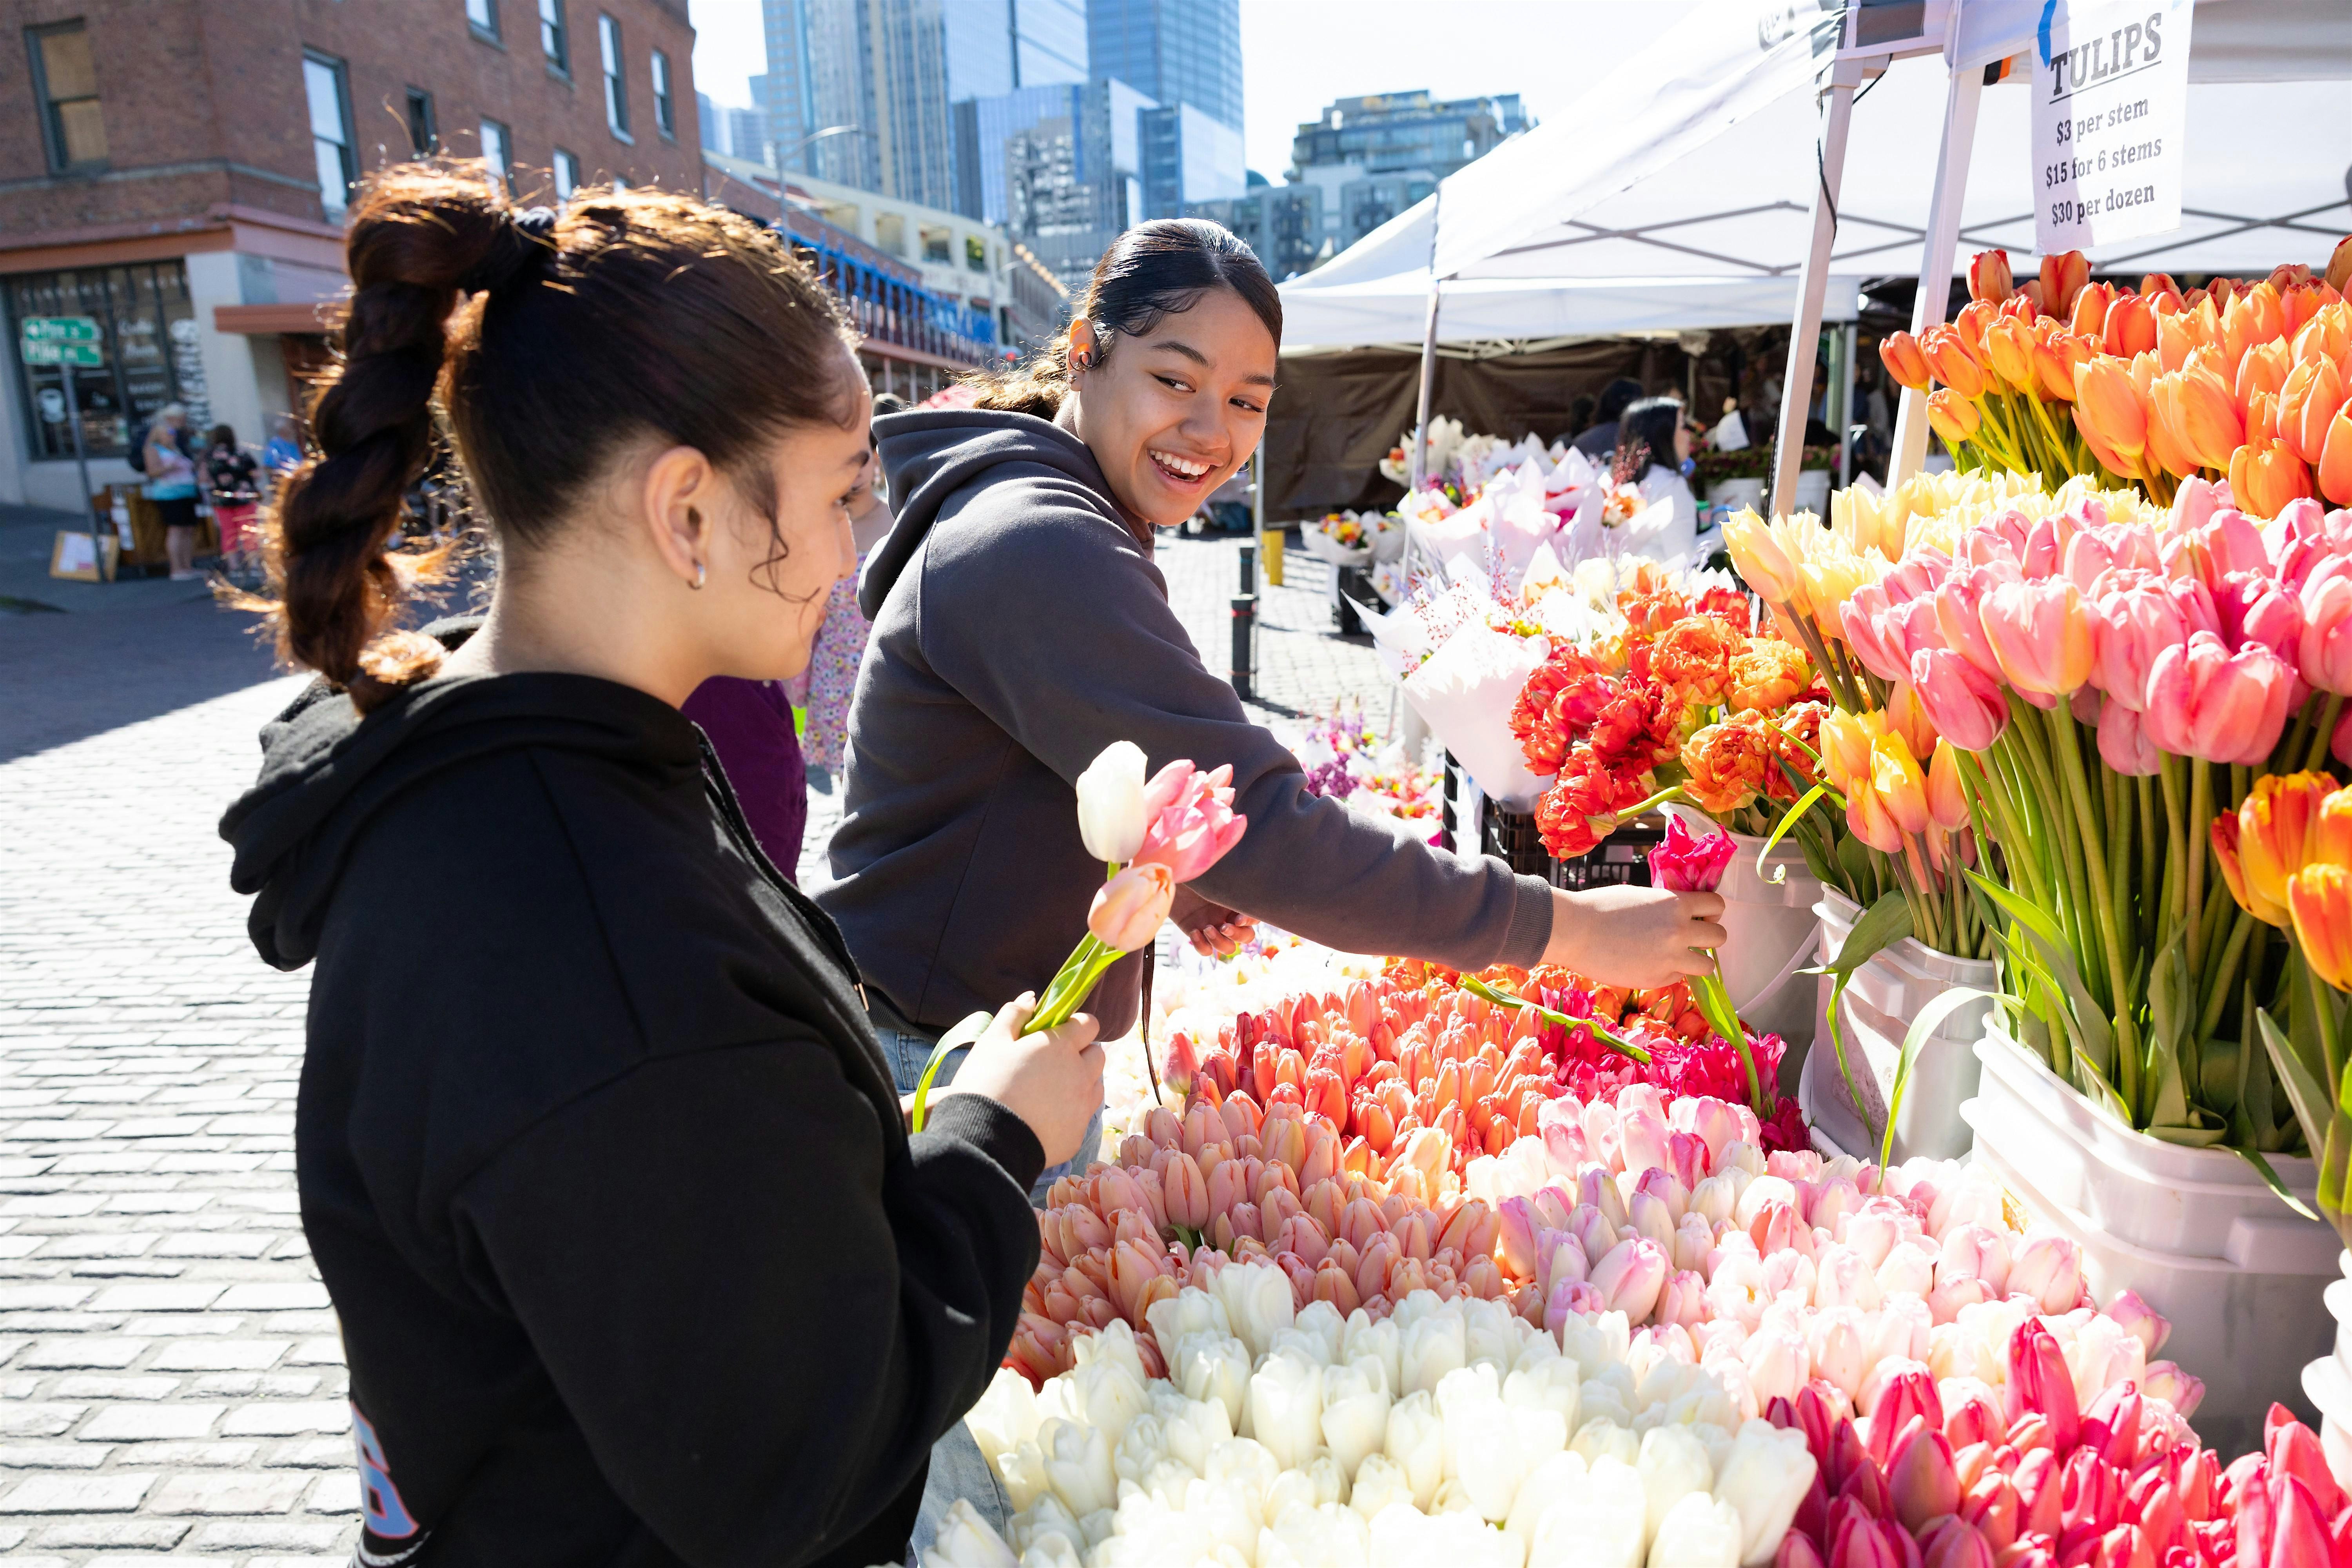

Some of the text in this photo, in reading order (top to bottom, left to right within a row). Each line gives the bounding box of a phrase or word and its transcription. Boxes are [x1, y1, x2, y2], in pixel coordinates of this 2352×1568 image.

[2050, 13, 2162, 96] TULIPS
[2057, 99, 2148, 147] $3 per stem
[2046, 138, 2161, 189] $15 for 6 stems
[2052, 185, 2154, 227] $30 per dozen
